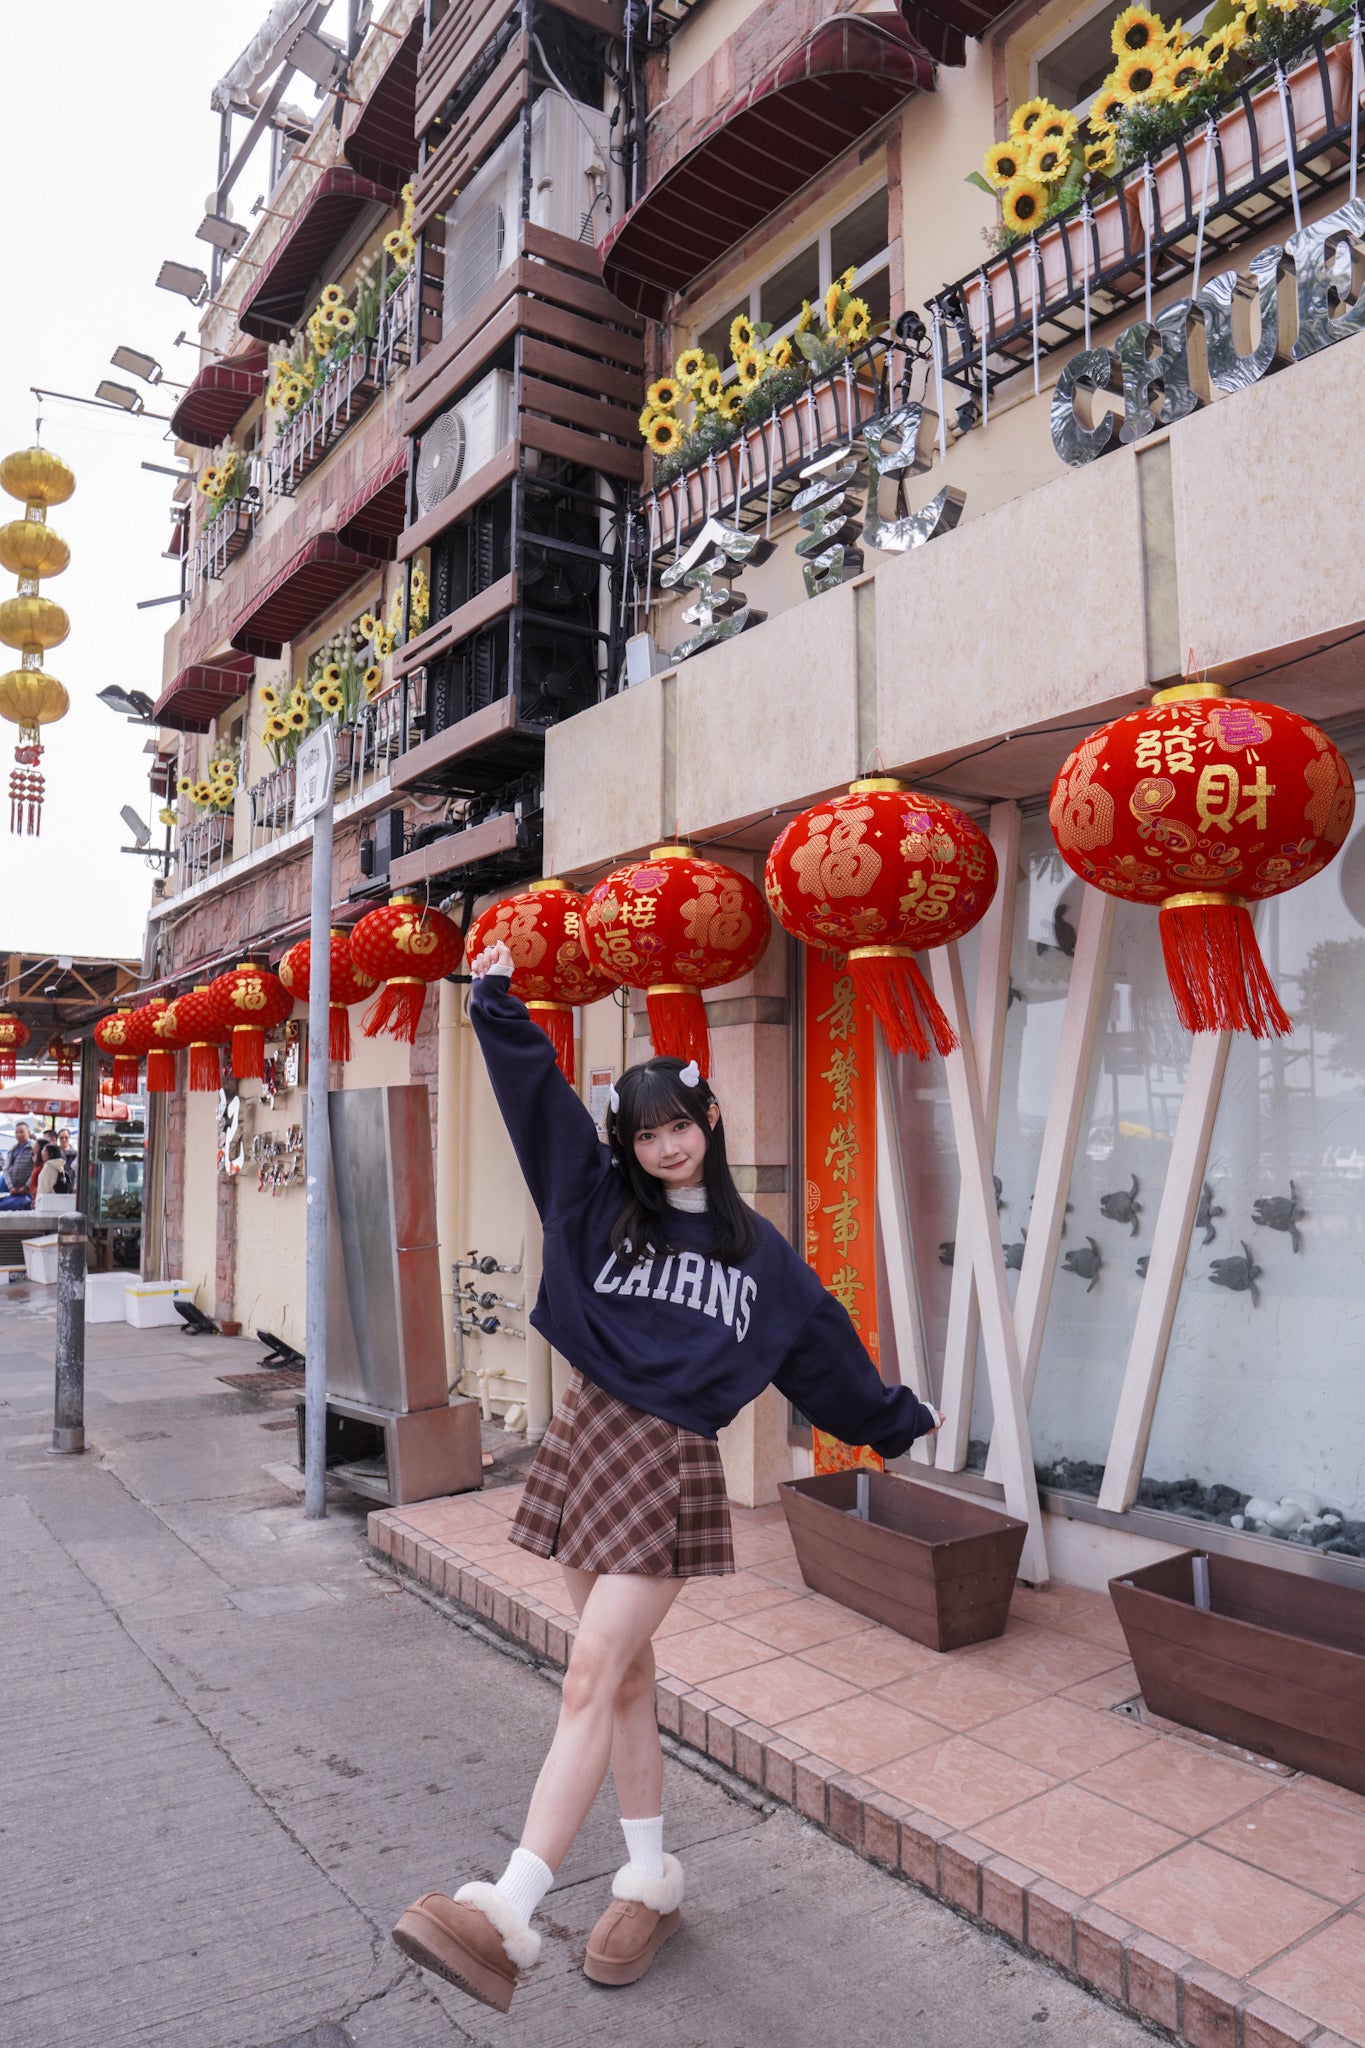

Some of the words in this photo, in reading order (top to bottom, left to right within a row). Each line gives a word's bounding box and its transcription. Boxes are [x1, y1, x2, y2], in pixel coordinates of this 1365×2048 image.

[660, 401, 966, 664] 全記
[1134, 725, 1276, 834] 發財
[789, 805, 883, 901] 福
[230, 978, 268, 1011] 福
[593, 1236, 758, 1344] CAIRNS
